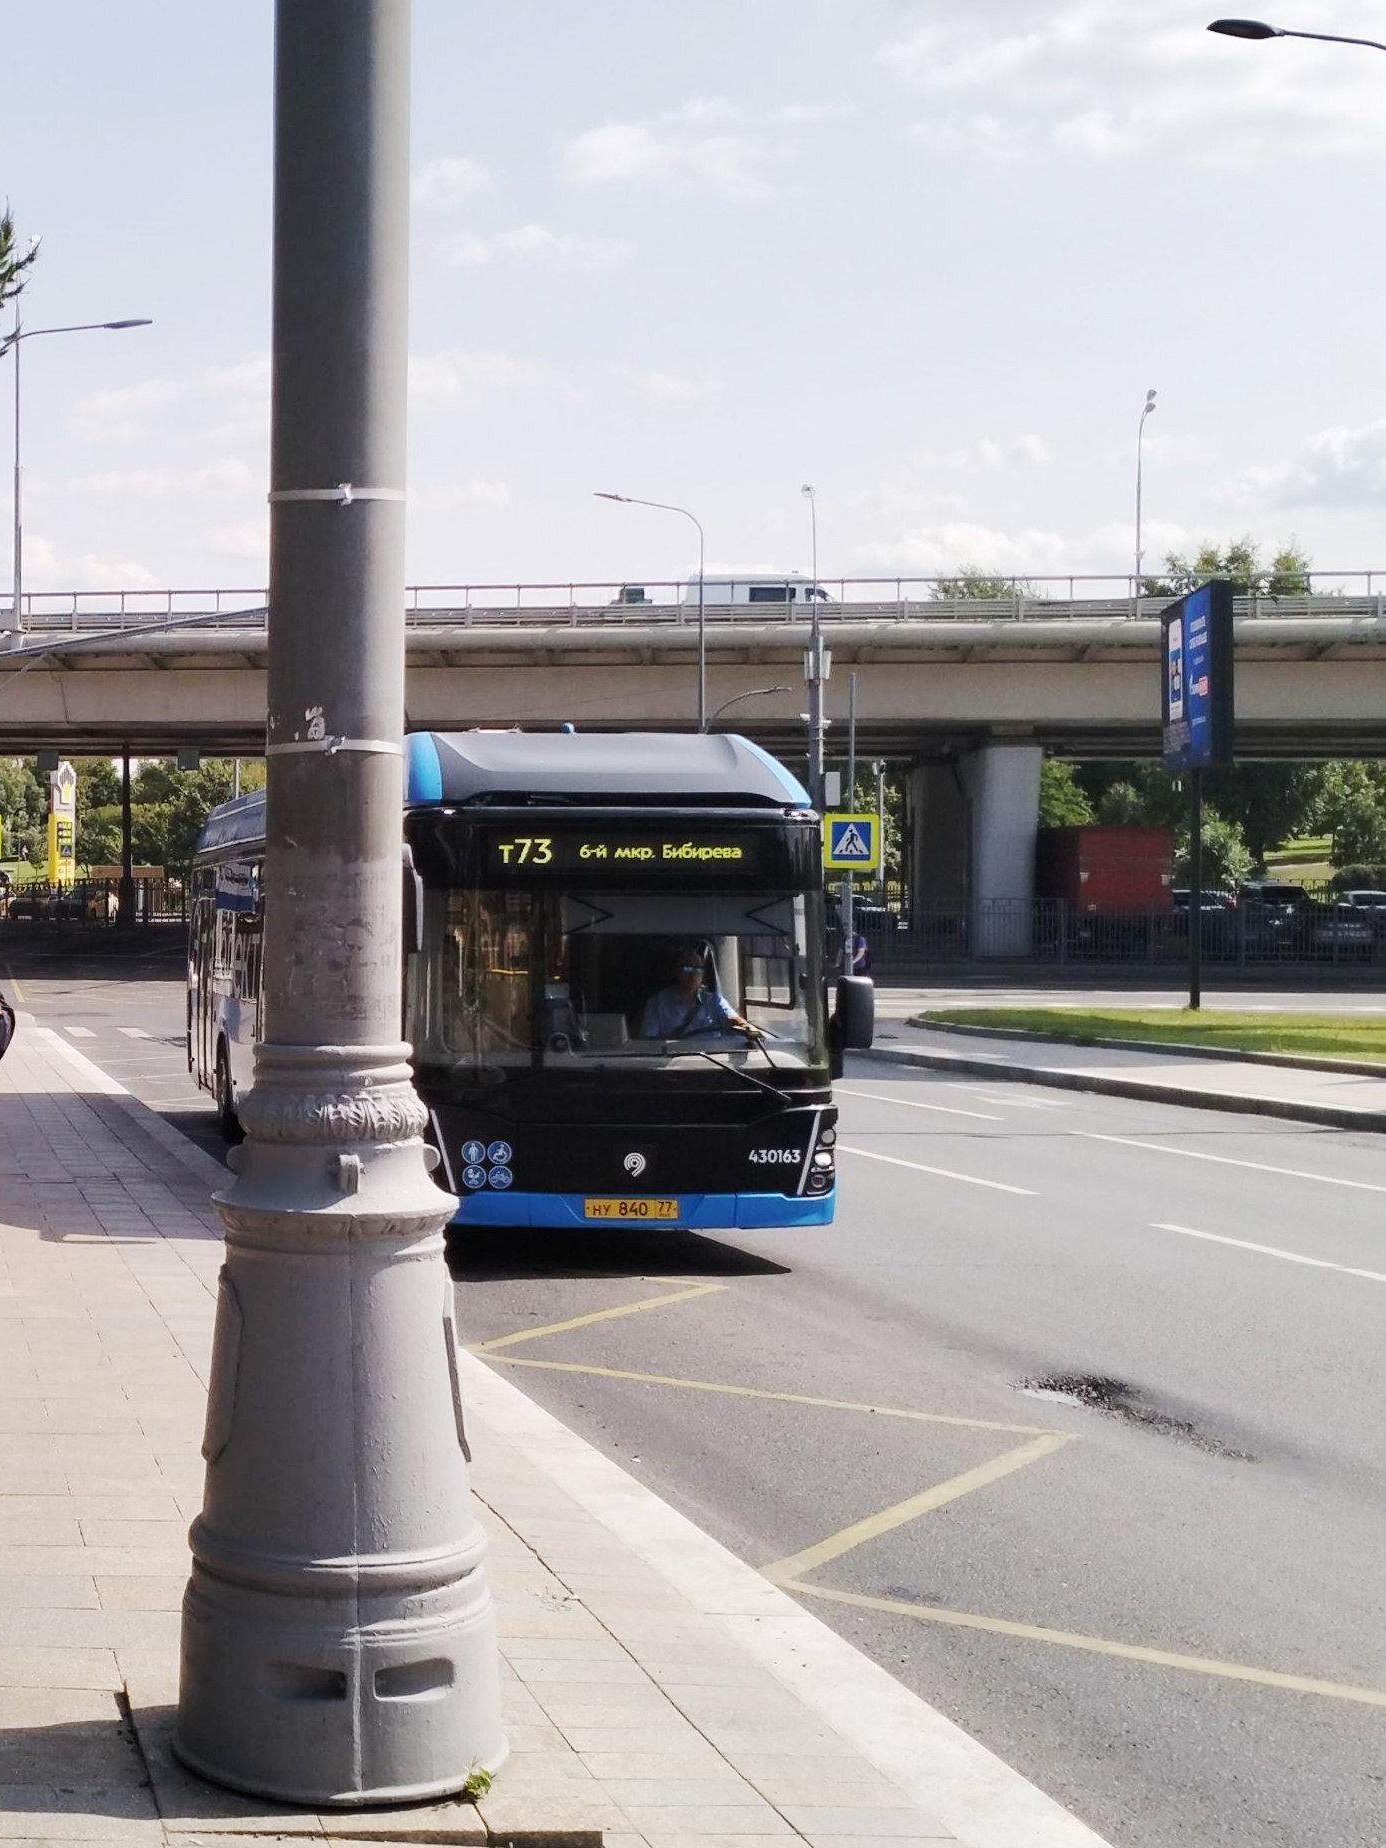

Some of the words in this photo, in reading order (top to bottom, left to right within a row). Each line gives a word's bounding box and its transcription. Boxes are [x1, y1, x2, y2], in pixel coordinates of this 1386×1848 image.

[498, 838, 553, 864] т73
[579, 844, 607, 859] 6-й
[614, 847, 655, 860] мкр.
[662, 842, 743, 860] Бибирева
[748, 1149, 801, 1164] 430163
[618, 1201, 648, 1216] 840
[658, 1201, 672, 1213] 77
